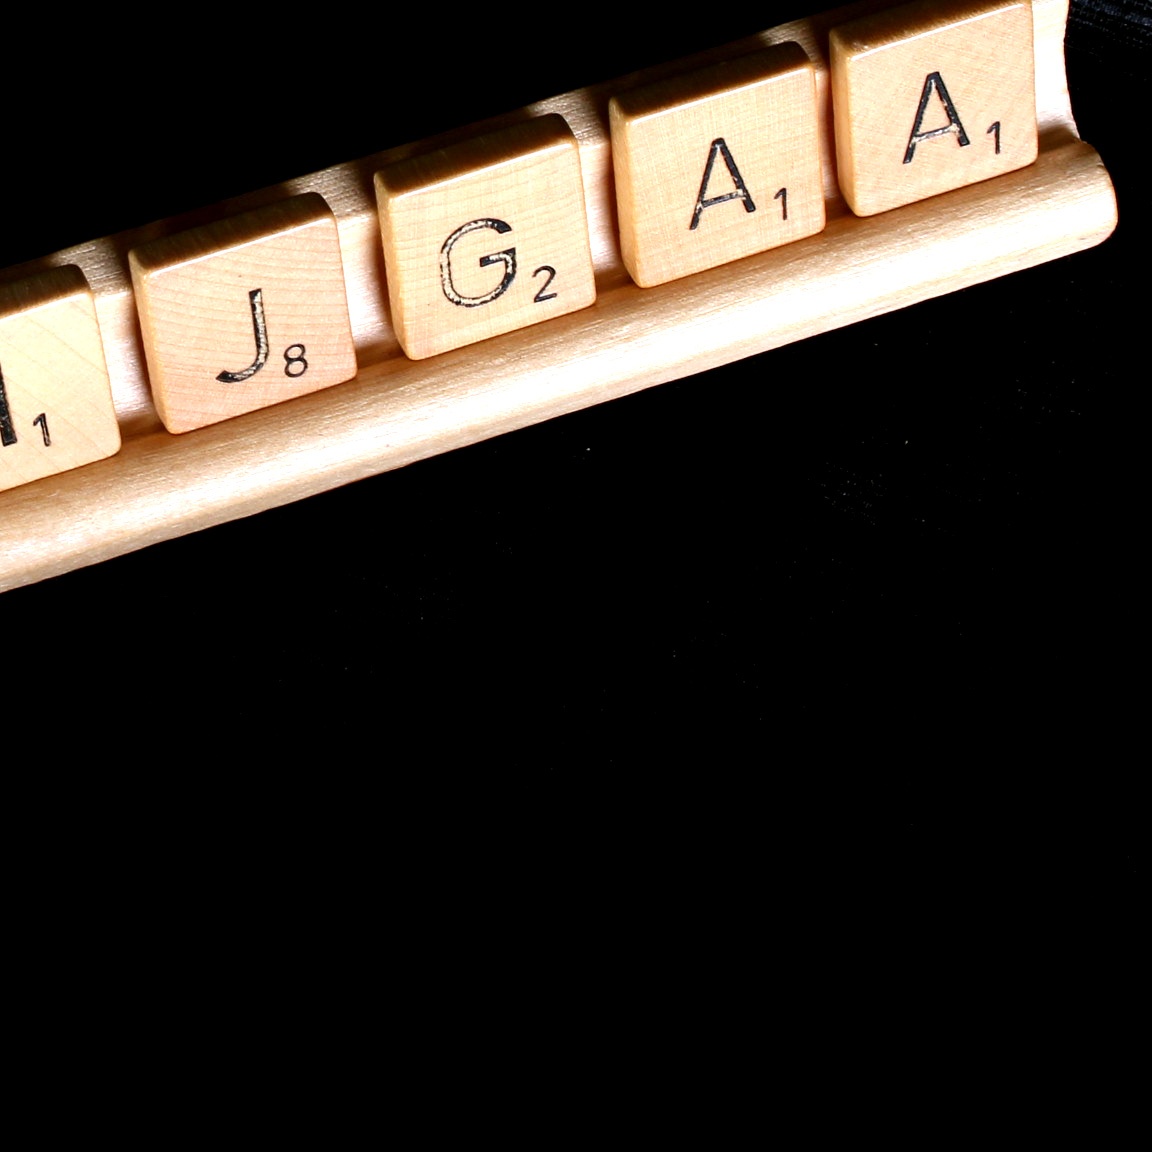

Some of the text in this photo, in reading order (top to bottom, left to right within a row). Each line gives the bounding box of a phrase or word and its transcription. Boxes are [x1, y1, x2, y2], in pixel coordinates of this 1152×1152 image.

[902, 70, 1001, 165] A 1
[688, 137, 788, 231] A 1
[439, 217, 558, 308] G 2
[215, 287, 309, 384] J 8
[32, 412, 52, 448] 1
